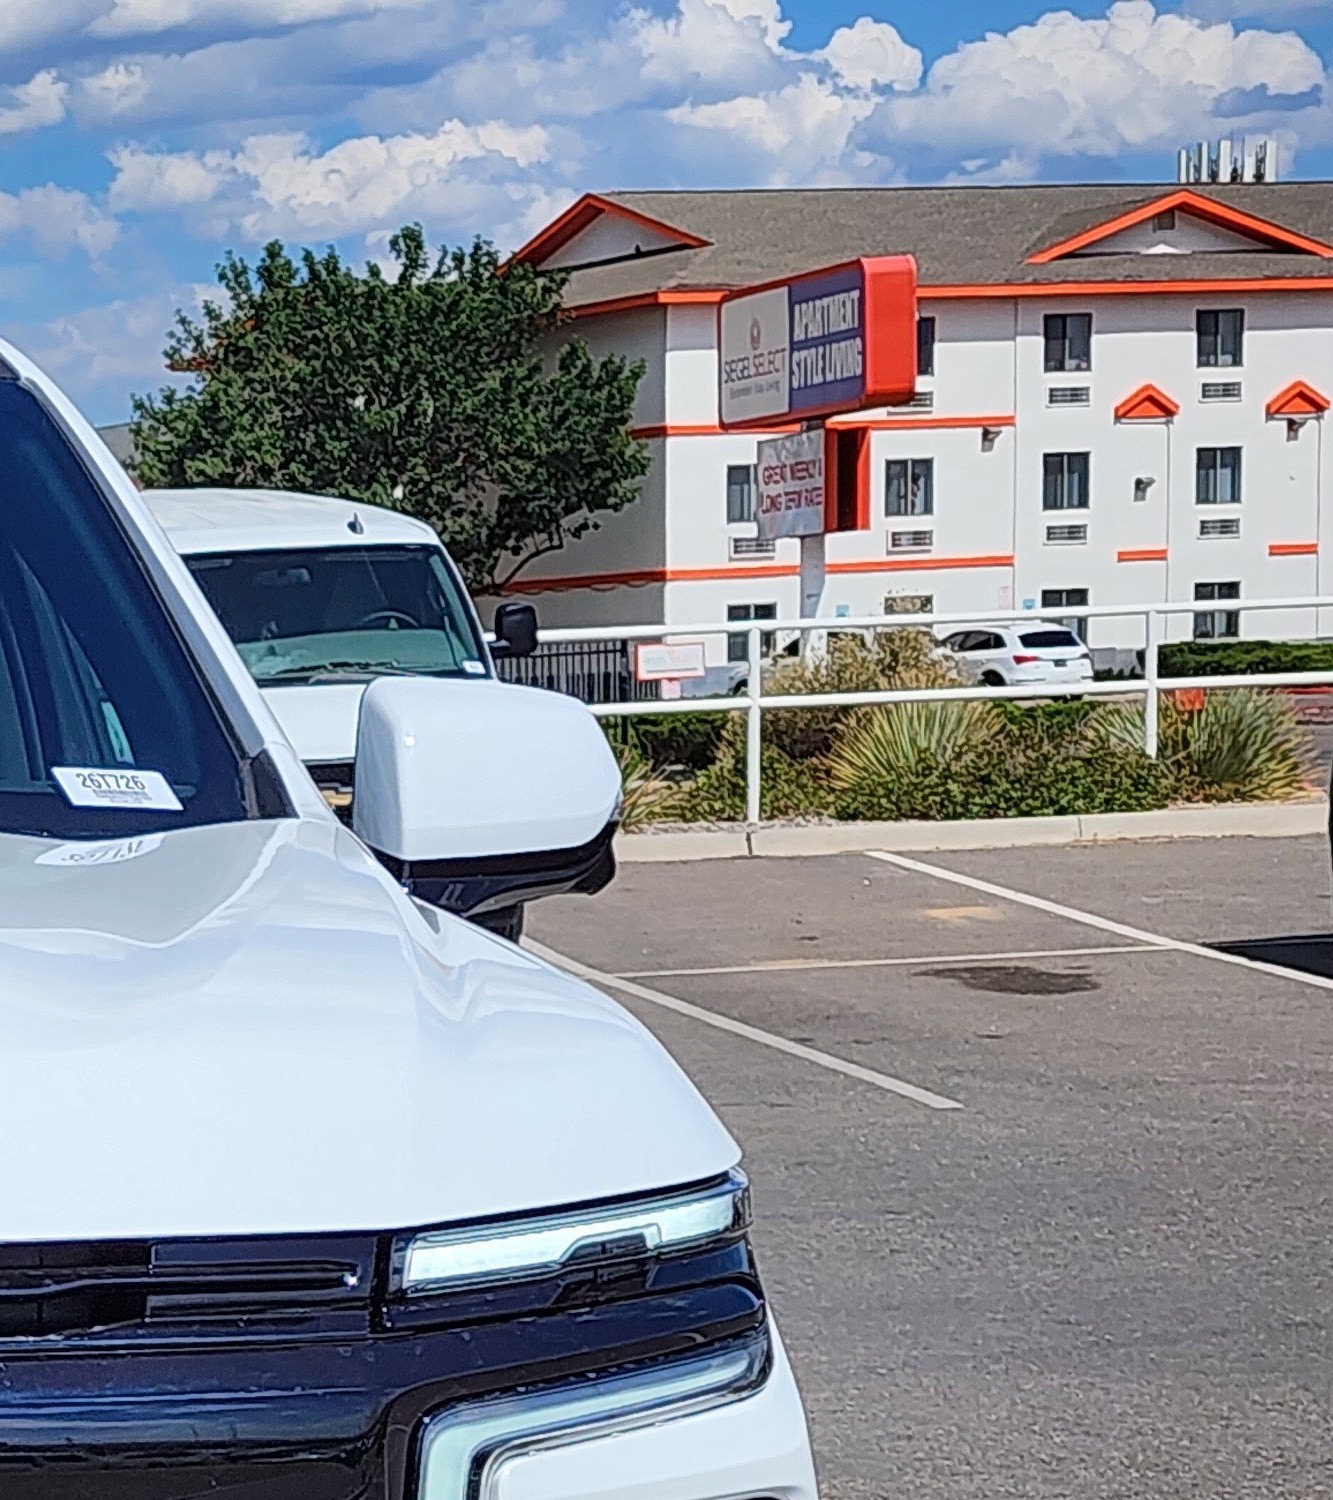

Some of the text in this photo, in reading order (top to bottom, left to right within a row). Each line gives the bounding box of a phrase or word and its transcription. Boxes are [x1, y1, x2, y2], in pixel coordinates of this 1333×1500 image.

[793, 289, 860, 342] APARTMENT
[753, 348, 787, 377] SELECT
[792, 337, 862, 389] STYLE LIVING
[75, 772, 146, 791] 26T726
